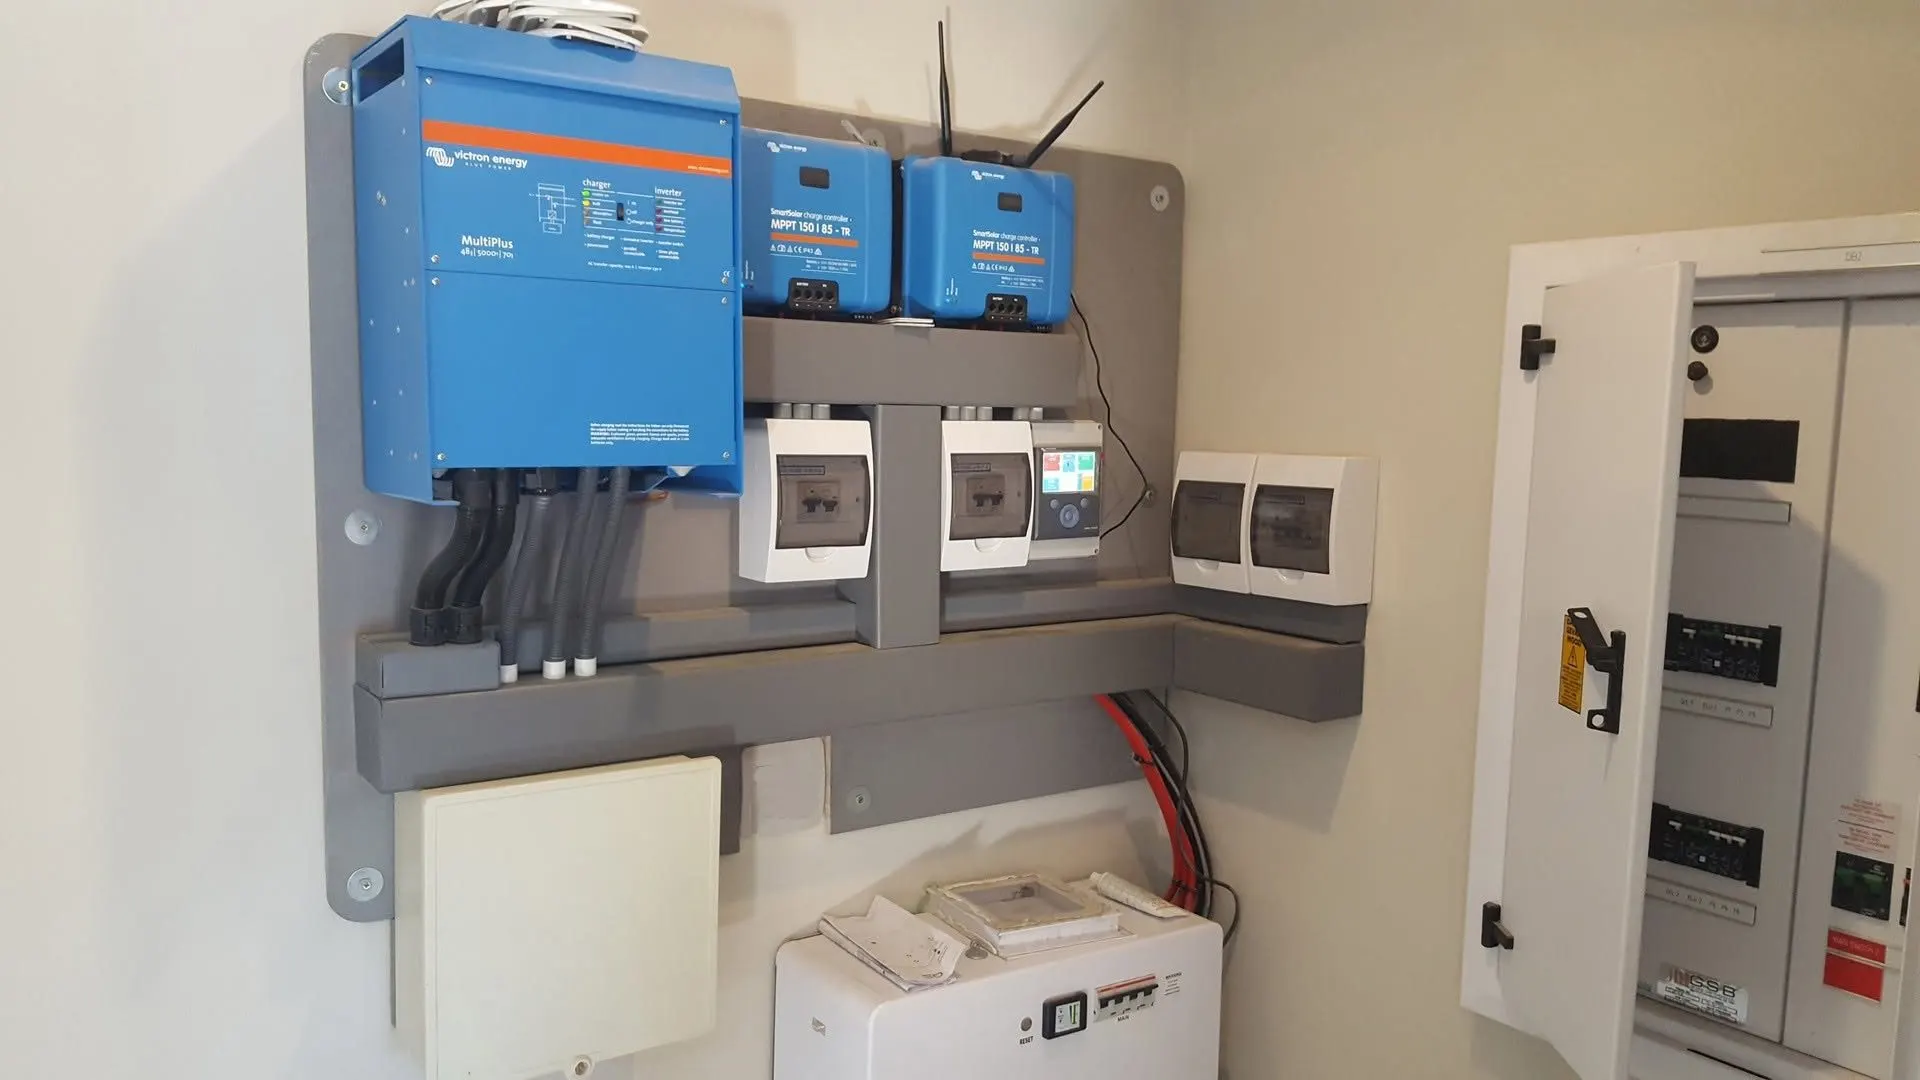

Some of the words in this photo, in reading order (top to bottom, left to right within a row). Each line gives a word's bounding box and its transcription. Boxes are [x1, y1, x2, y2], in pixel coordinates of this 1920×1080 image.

[454, 149, 490, 162] victron
[492, 155, 528, 169] energy
[488, 163, 512, 171] POWER
[582, 178, 611, 190] charger
[654, 186, 682, 198] inverter
[770, 207, 803, 219] SmartSolar
[803, 211, 823, 222] charge
[823, 213, 849, 223] controller
[770, 218, 797, 232] MPPT
[798, 220, 815, 234] 150
[821, 224, 834, 236] 85
[840, 226, 851, 237] TR
[461, 234, 514, 249] MultiPlus
[973, 229, 1001, 239] SmartSolar
[1000, 232, 1017, 241] charge
[1017, 234, 1038, 243] controller
[972, 239, 995, 250] MPPT
[996, 241, 1009, 252] 150
[1014, 243, 1025, 254] 85
[1030, 245, 1040, 255] TR
[1117, 1014, 1130, 1022] MAIN
[1019, 1035, 1034, 1045] RESET
